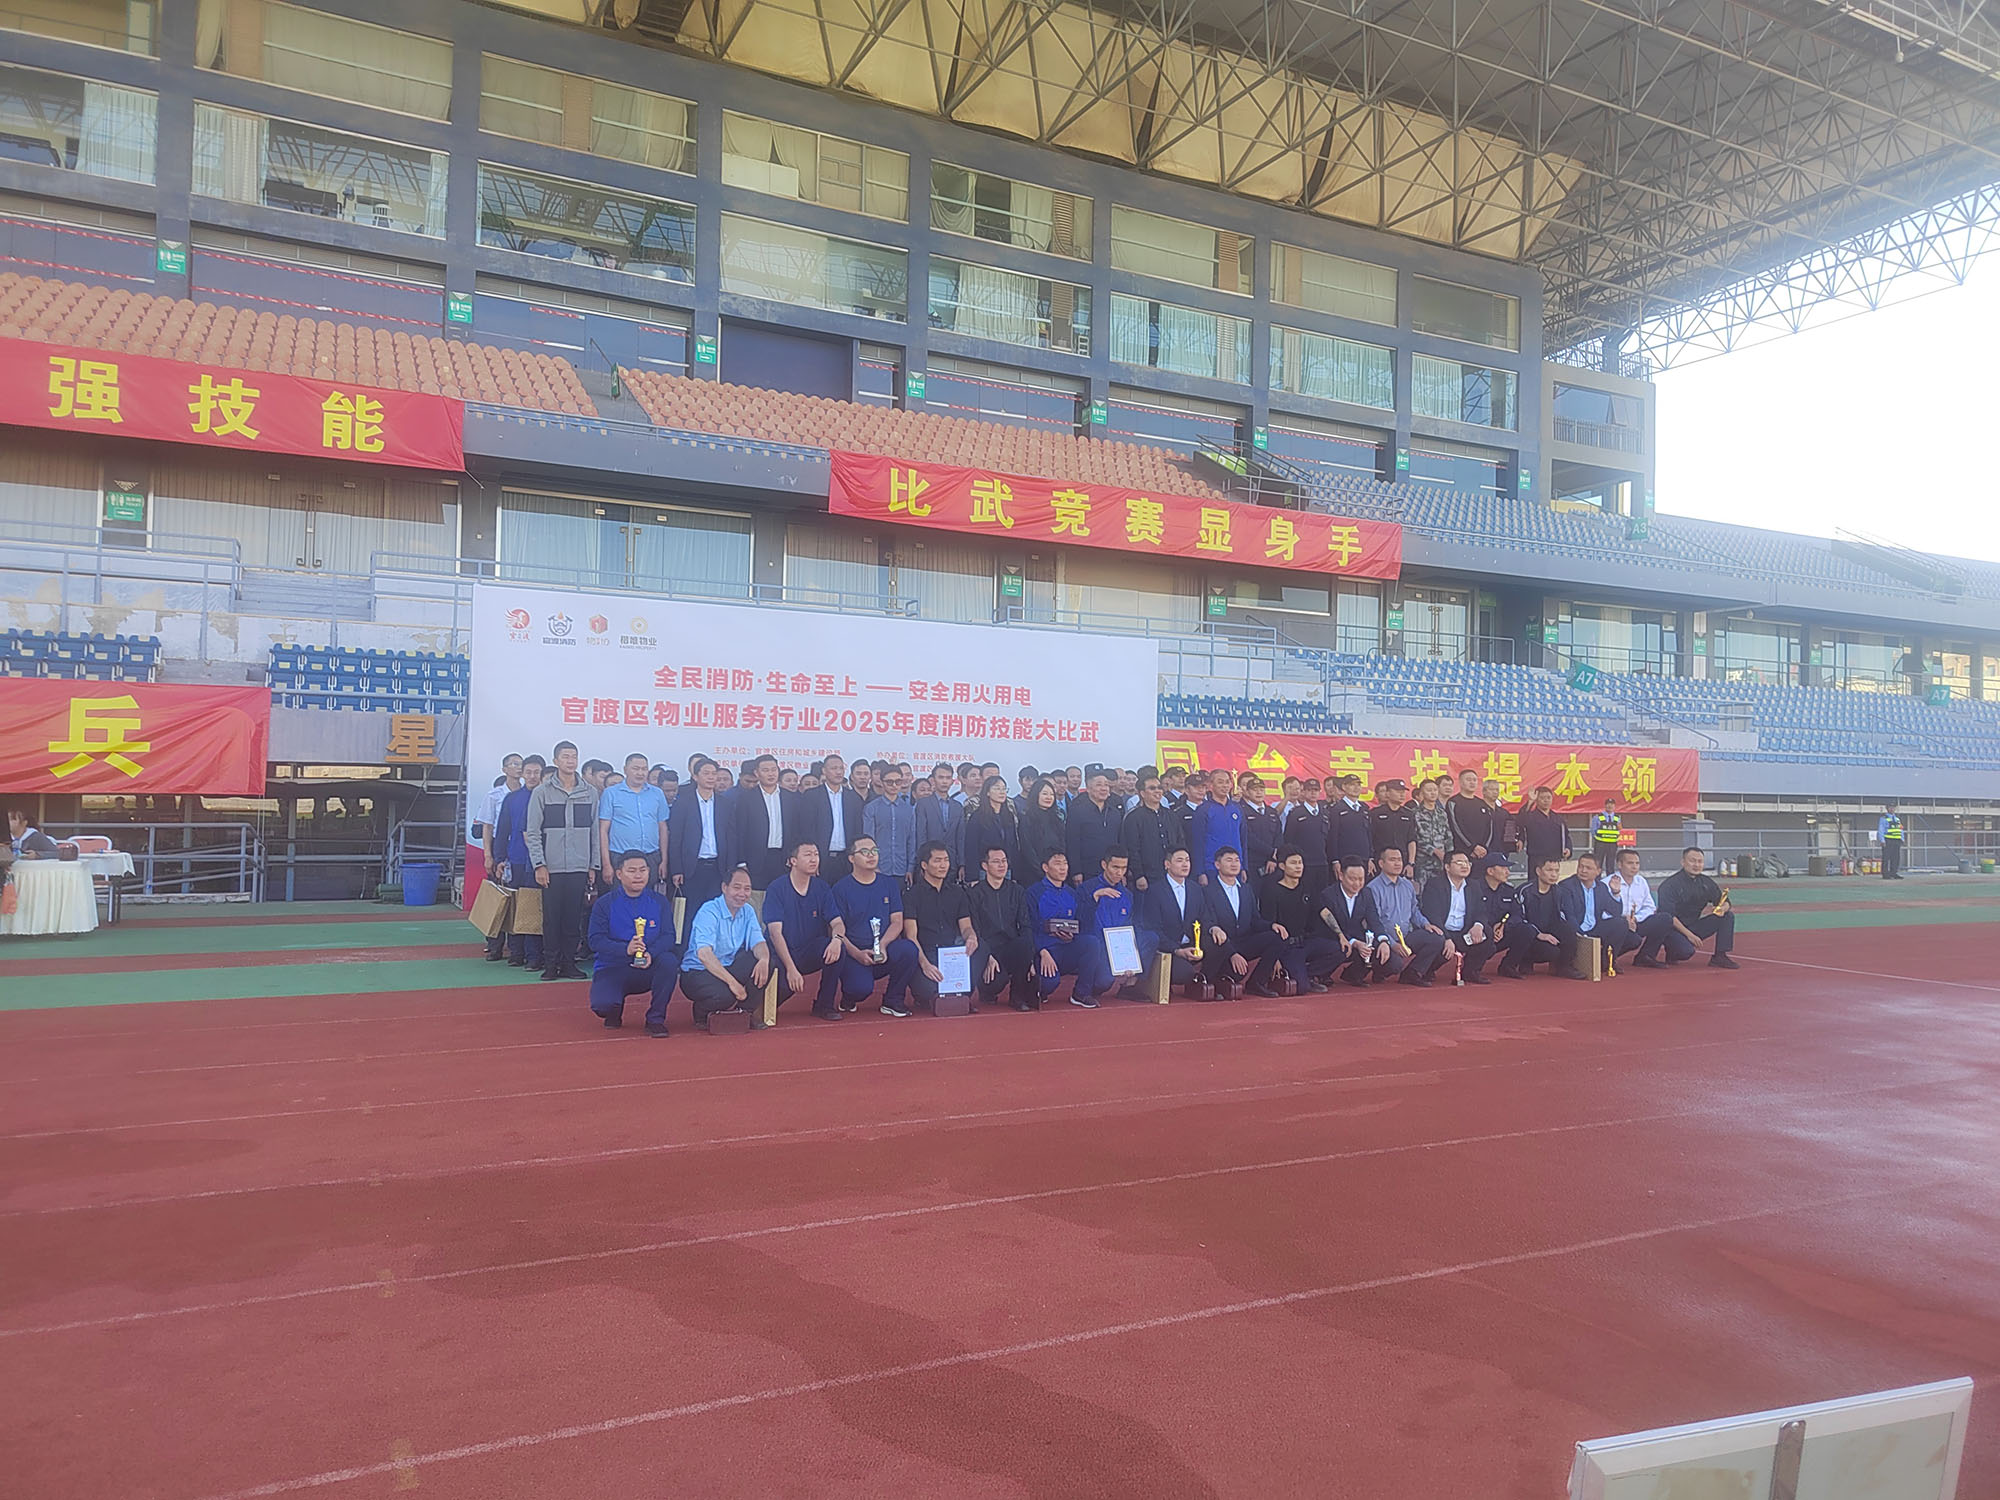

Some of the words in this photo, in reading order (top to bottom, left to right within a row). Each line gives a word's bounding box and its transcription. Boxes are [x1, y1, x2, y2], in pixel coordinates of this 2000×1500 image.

[48, 356, 386, 453] 强技能
[888, 467, 1364, 567] 比武竞赛显身手
[1632, 522, 1647, 535] A3
[1576, 670, 1594, 686] A7
[1931, 687, 1949, 701] A7
[48, 694, 151, 779] 兵
[385, 714, 440, 763] 星
[561, 696, 1099, 744] 官渡区物业服务行业2025年度消防技能大比武
